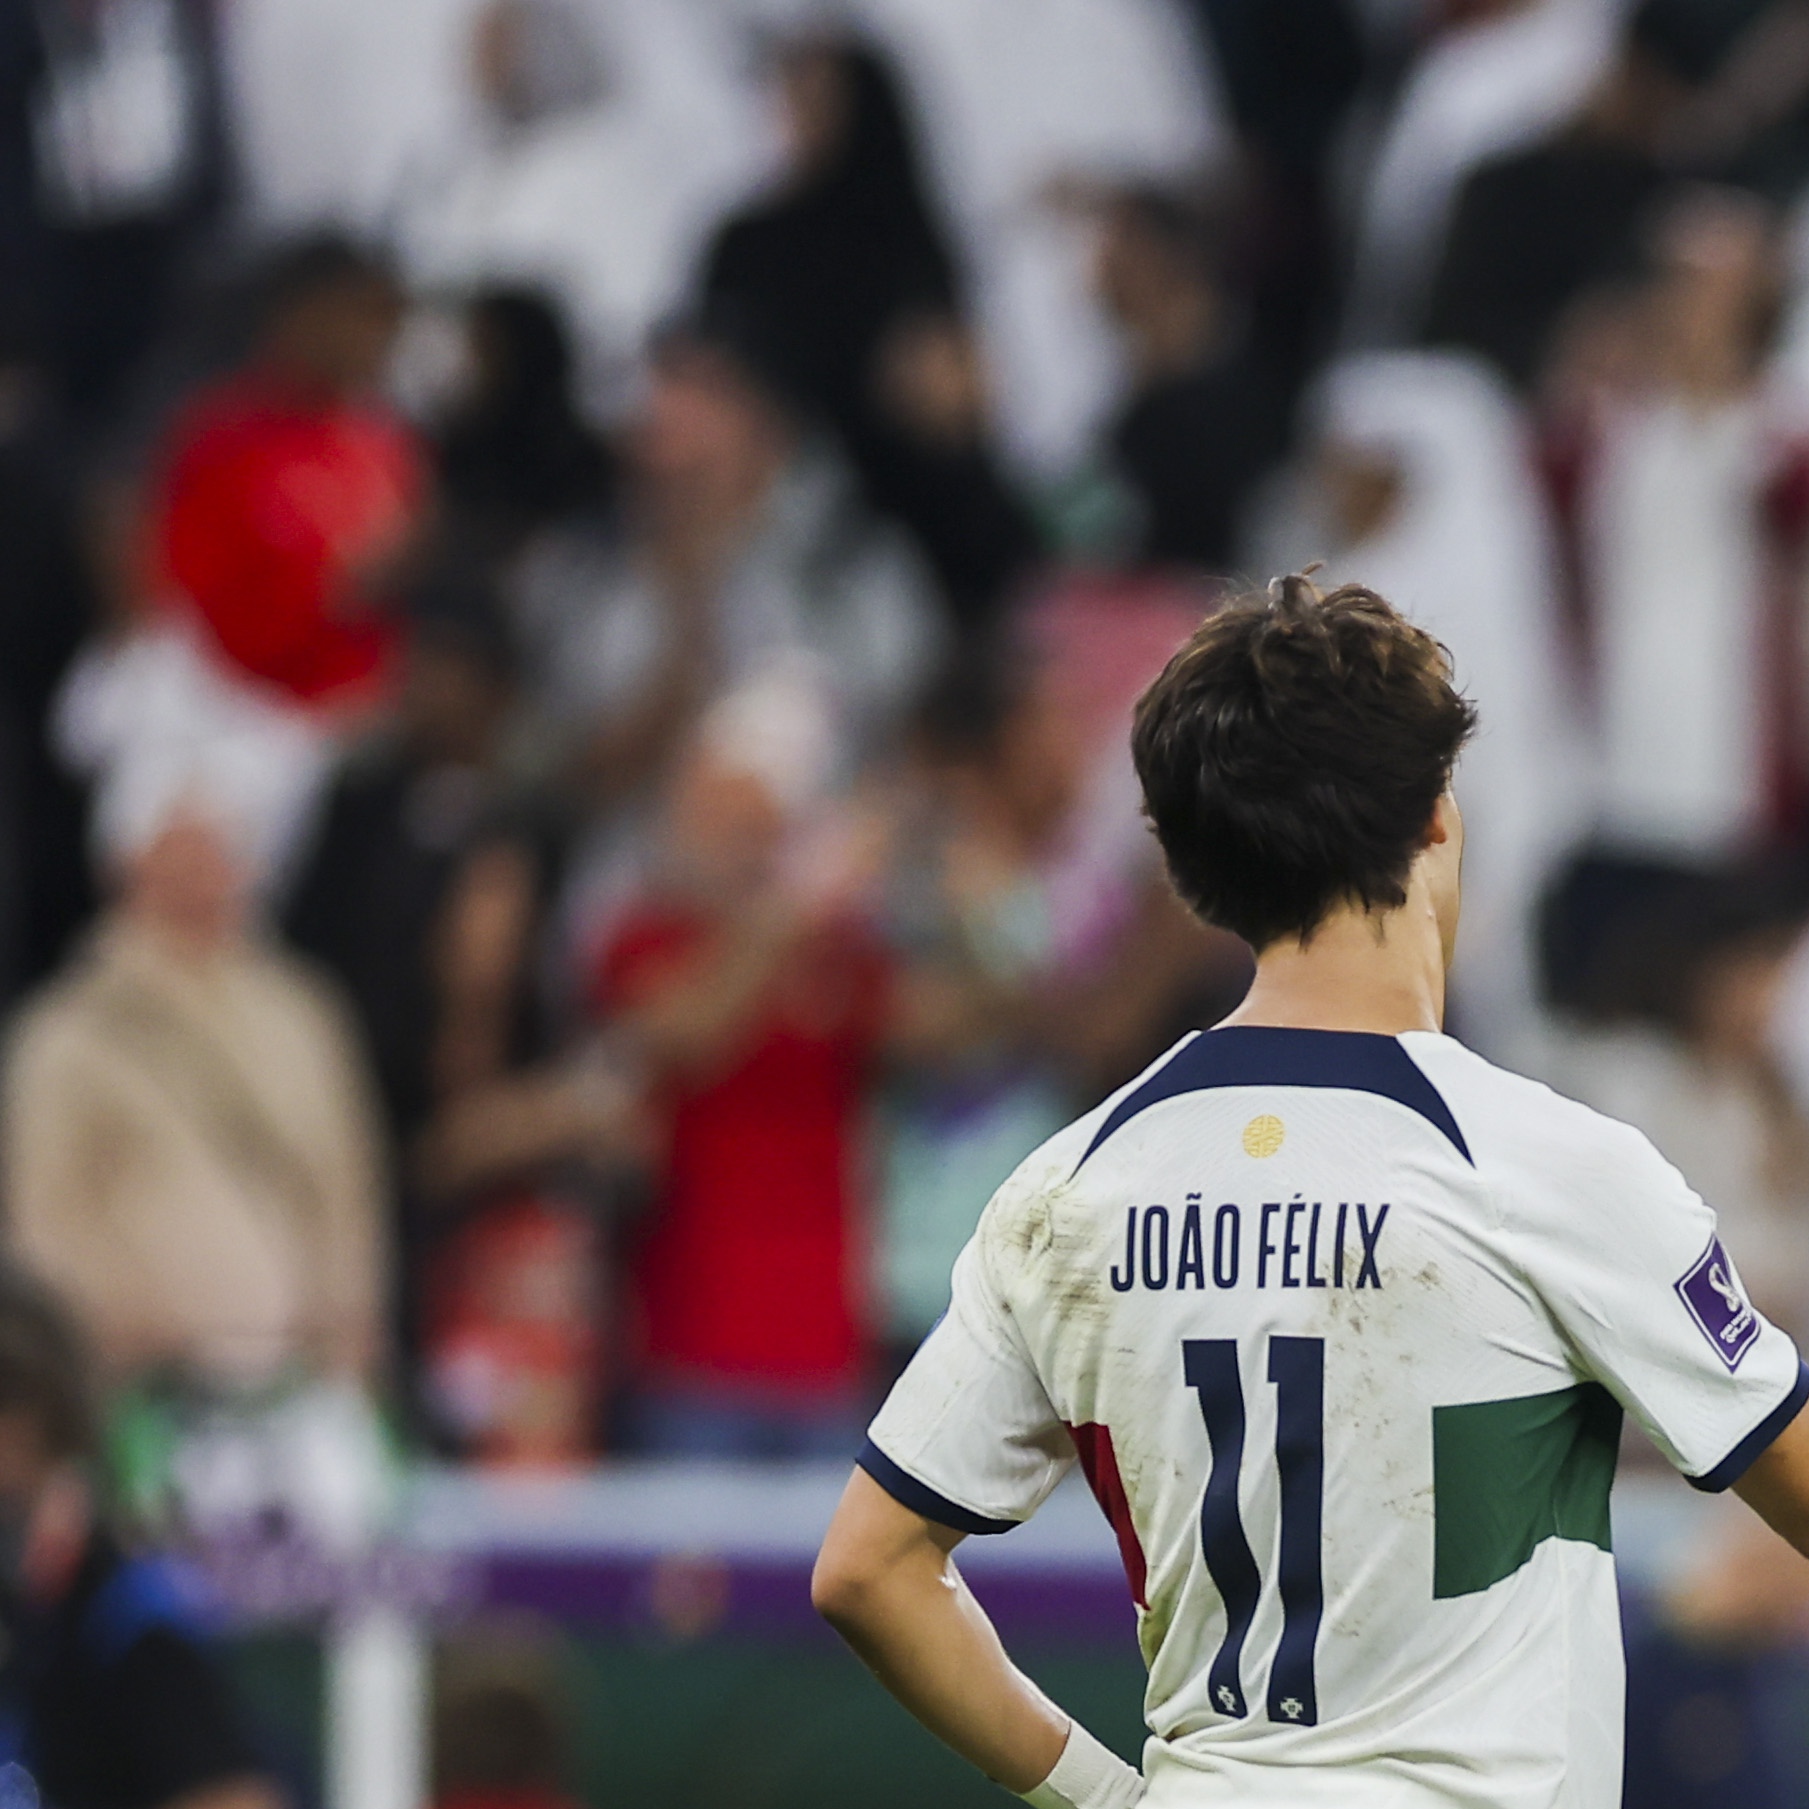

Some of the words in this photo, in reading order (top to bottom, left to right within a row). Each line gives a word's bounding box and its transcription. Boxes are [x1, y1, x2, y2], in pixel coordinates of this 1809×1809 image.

[1109, 1191, 1240, 1293] JOÃO
[1256, 1191, 1391, 1291] FÉLIX
[1182, 1334, 1326, 1728] 11
